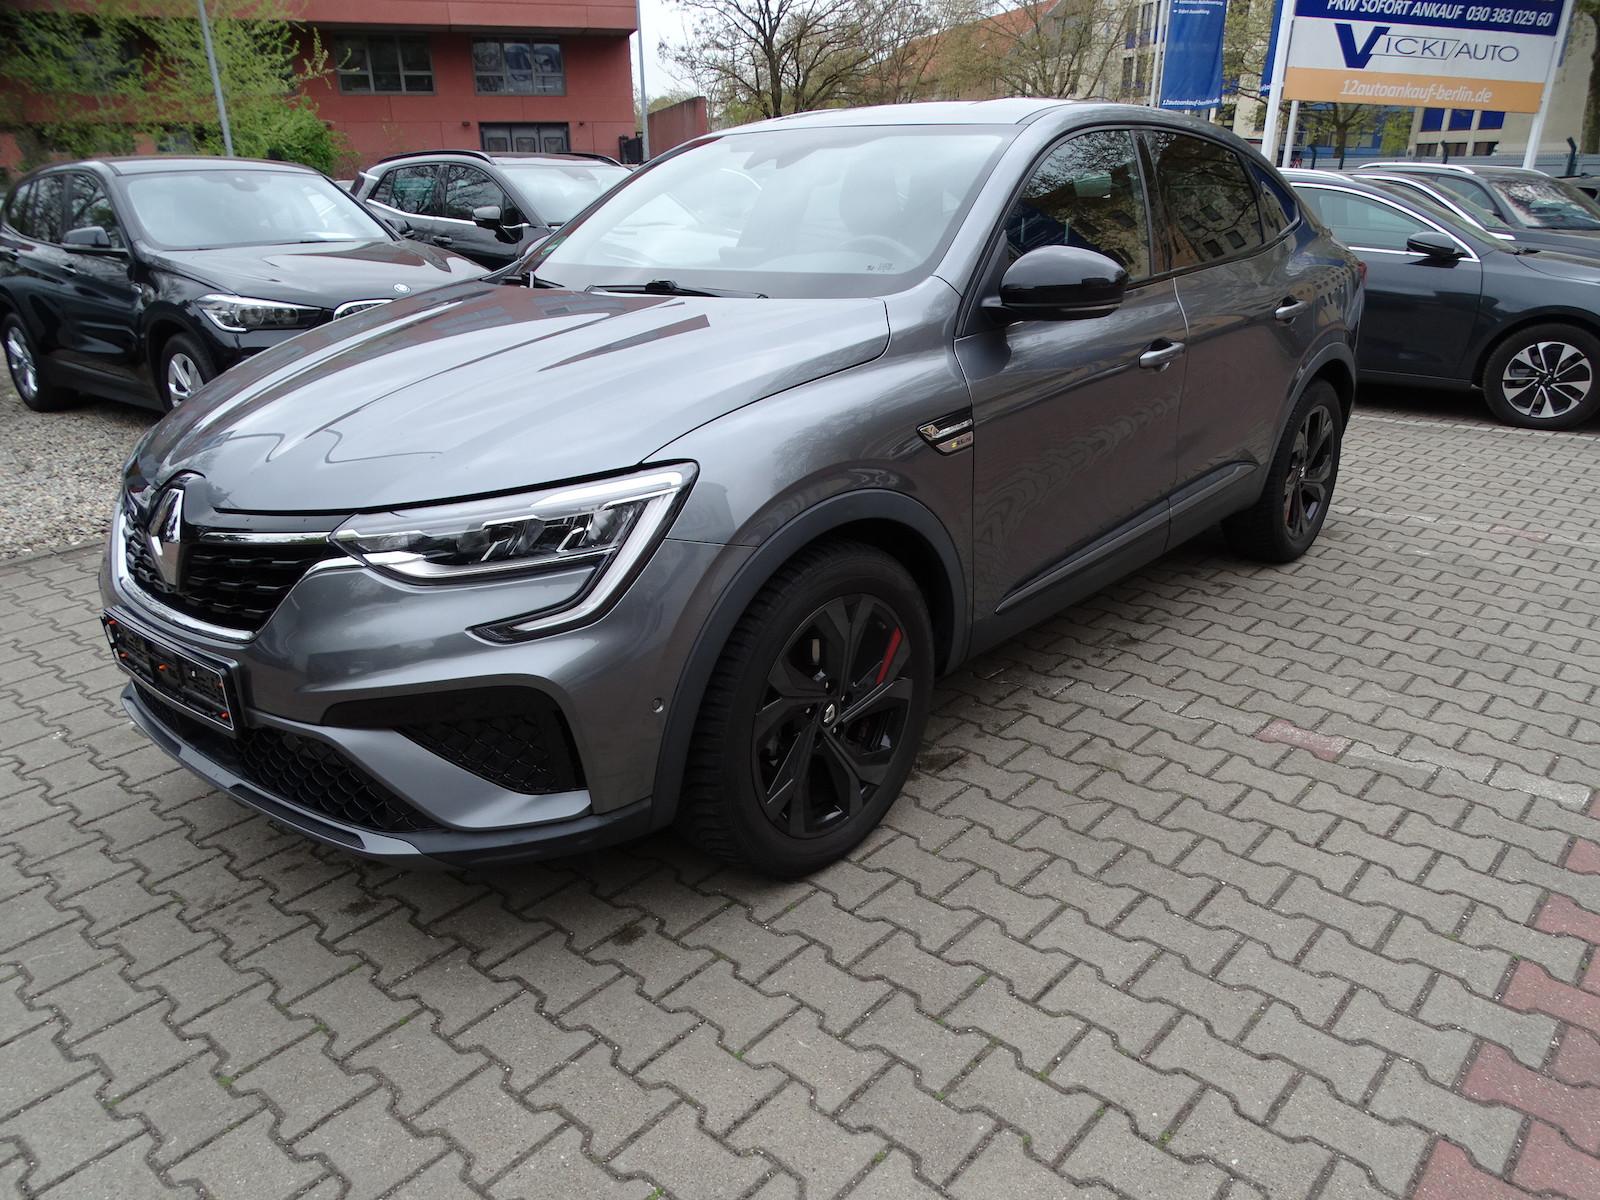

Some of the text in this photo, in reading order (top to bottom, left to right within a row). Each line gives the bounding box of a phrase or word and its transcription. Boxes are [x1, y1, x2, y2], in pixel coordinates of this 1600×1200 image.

[1327, 0, 1553, 27] PKW SOFORT ANKAUF 030 383 029 60
[1454, 43, 1519, 62] AUTO
[1340, 79, 1493, 103] 12autoankauf-berlin.de
